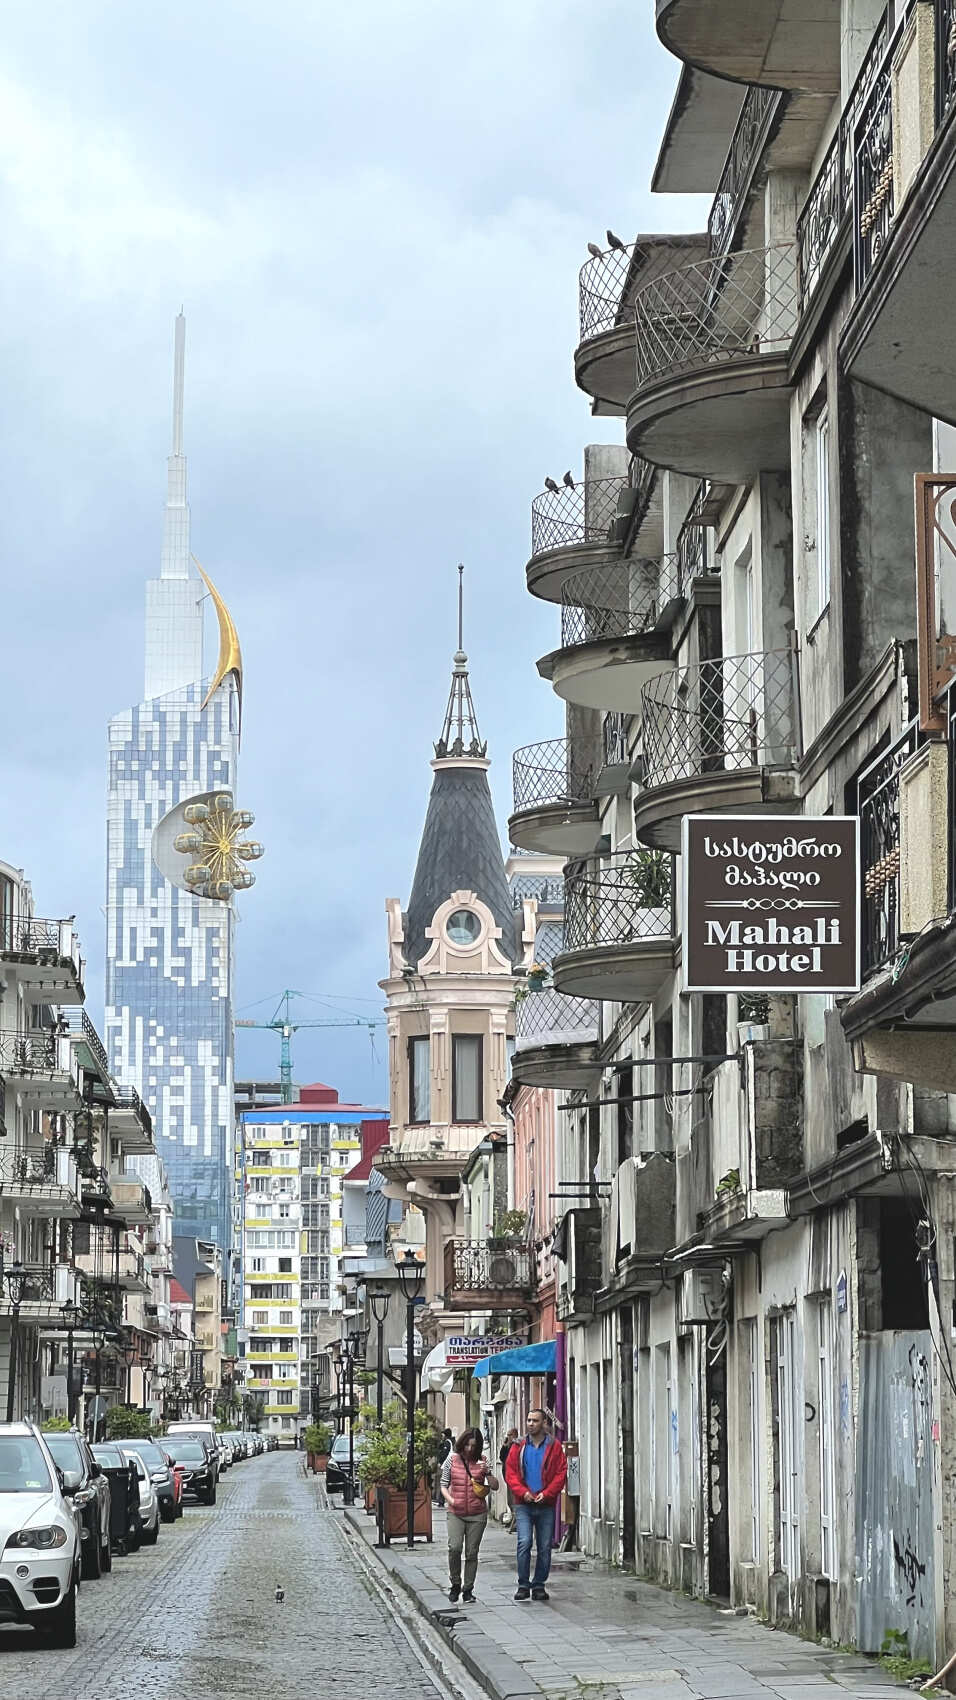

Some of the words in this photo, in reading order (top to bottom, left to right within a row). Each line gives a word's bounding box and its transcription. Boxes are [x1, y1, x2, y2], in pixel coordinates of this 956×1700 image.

[704, 837, 842, 863] სასტუმრო
[725, 865, 821, 891] მაჰალი
[704, 918, 842, 946] Mahali
[724, 947, 824, 973] Hotel
[449, 1346, 489, 1355] TRANSLATION
